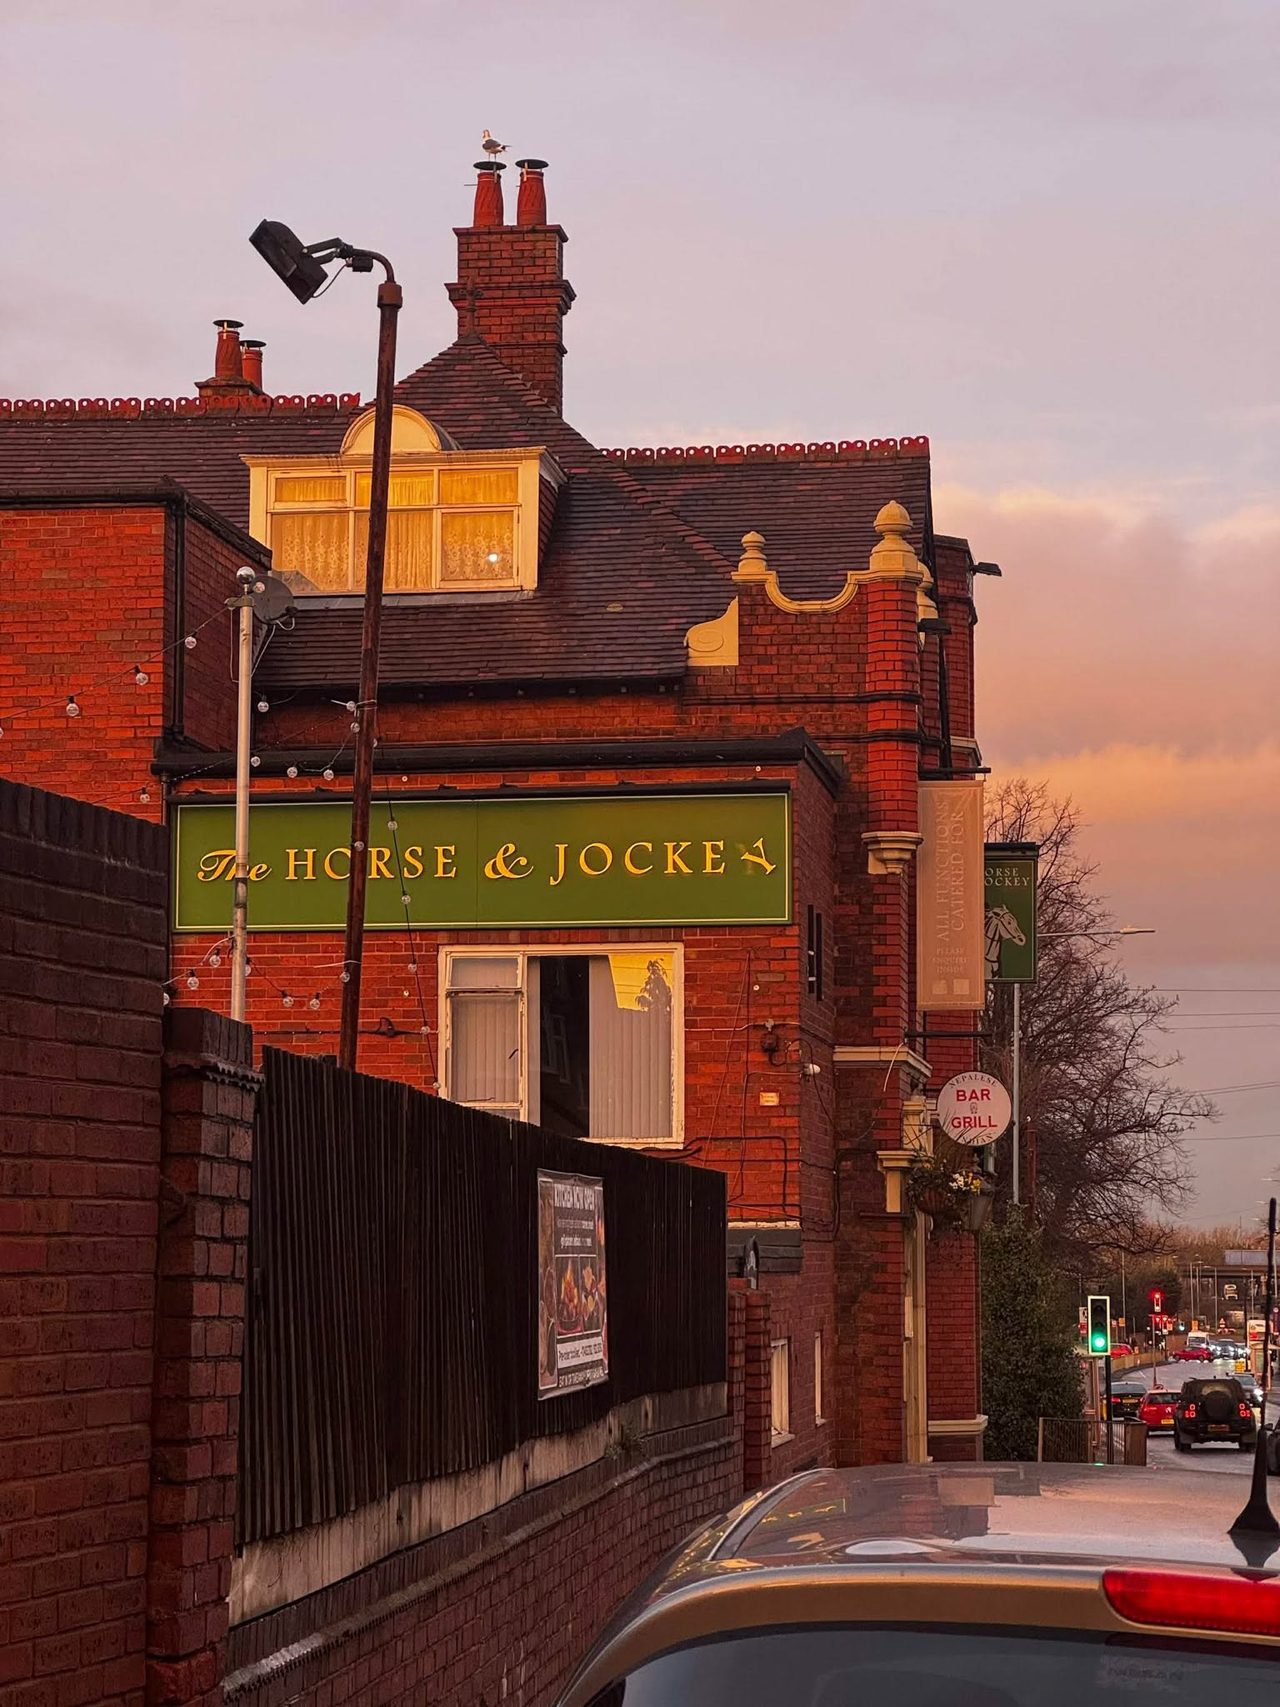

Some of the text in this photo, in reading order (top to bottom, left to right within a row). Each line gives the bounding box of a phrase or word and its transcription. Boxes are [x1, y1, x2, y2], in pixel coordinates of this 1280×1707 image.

[285, 845, 457, 881] HORSE
[484, 843, 534, 879] &
[550, 837, 776, 886] JOCKEY
[936, 801, 949, 941] ALL FUNCTIONS
[951, 811, 964, 931] CATERED FOR
[984, 867, 1019, 877] ORSE
[984, 877, 1030, 887] OCKEY
[948, 1074, 997, 1088] NEPALESE
[956, 1088, 991, 1102] BAR
[951, 1115, 998, 1129] GRILL
